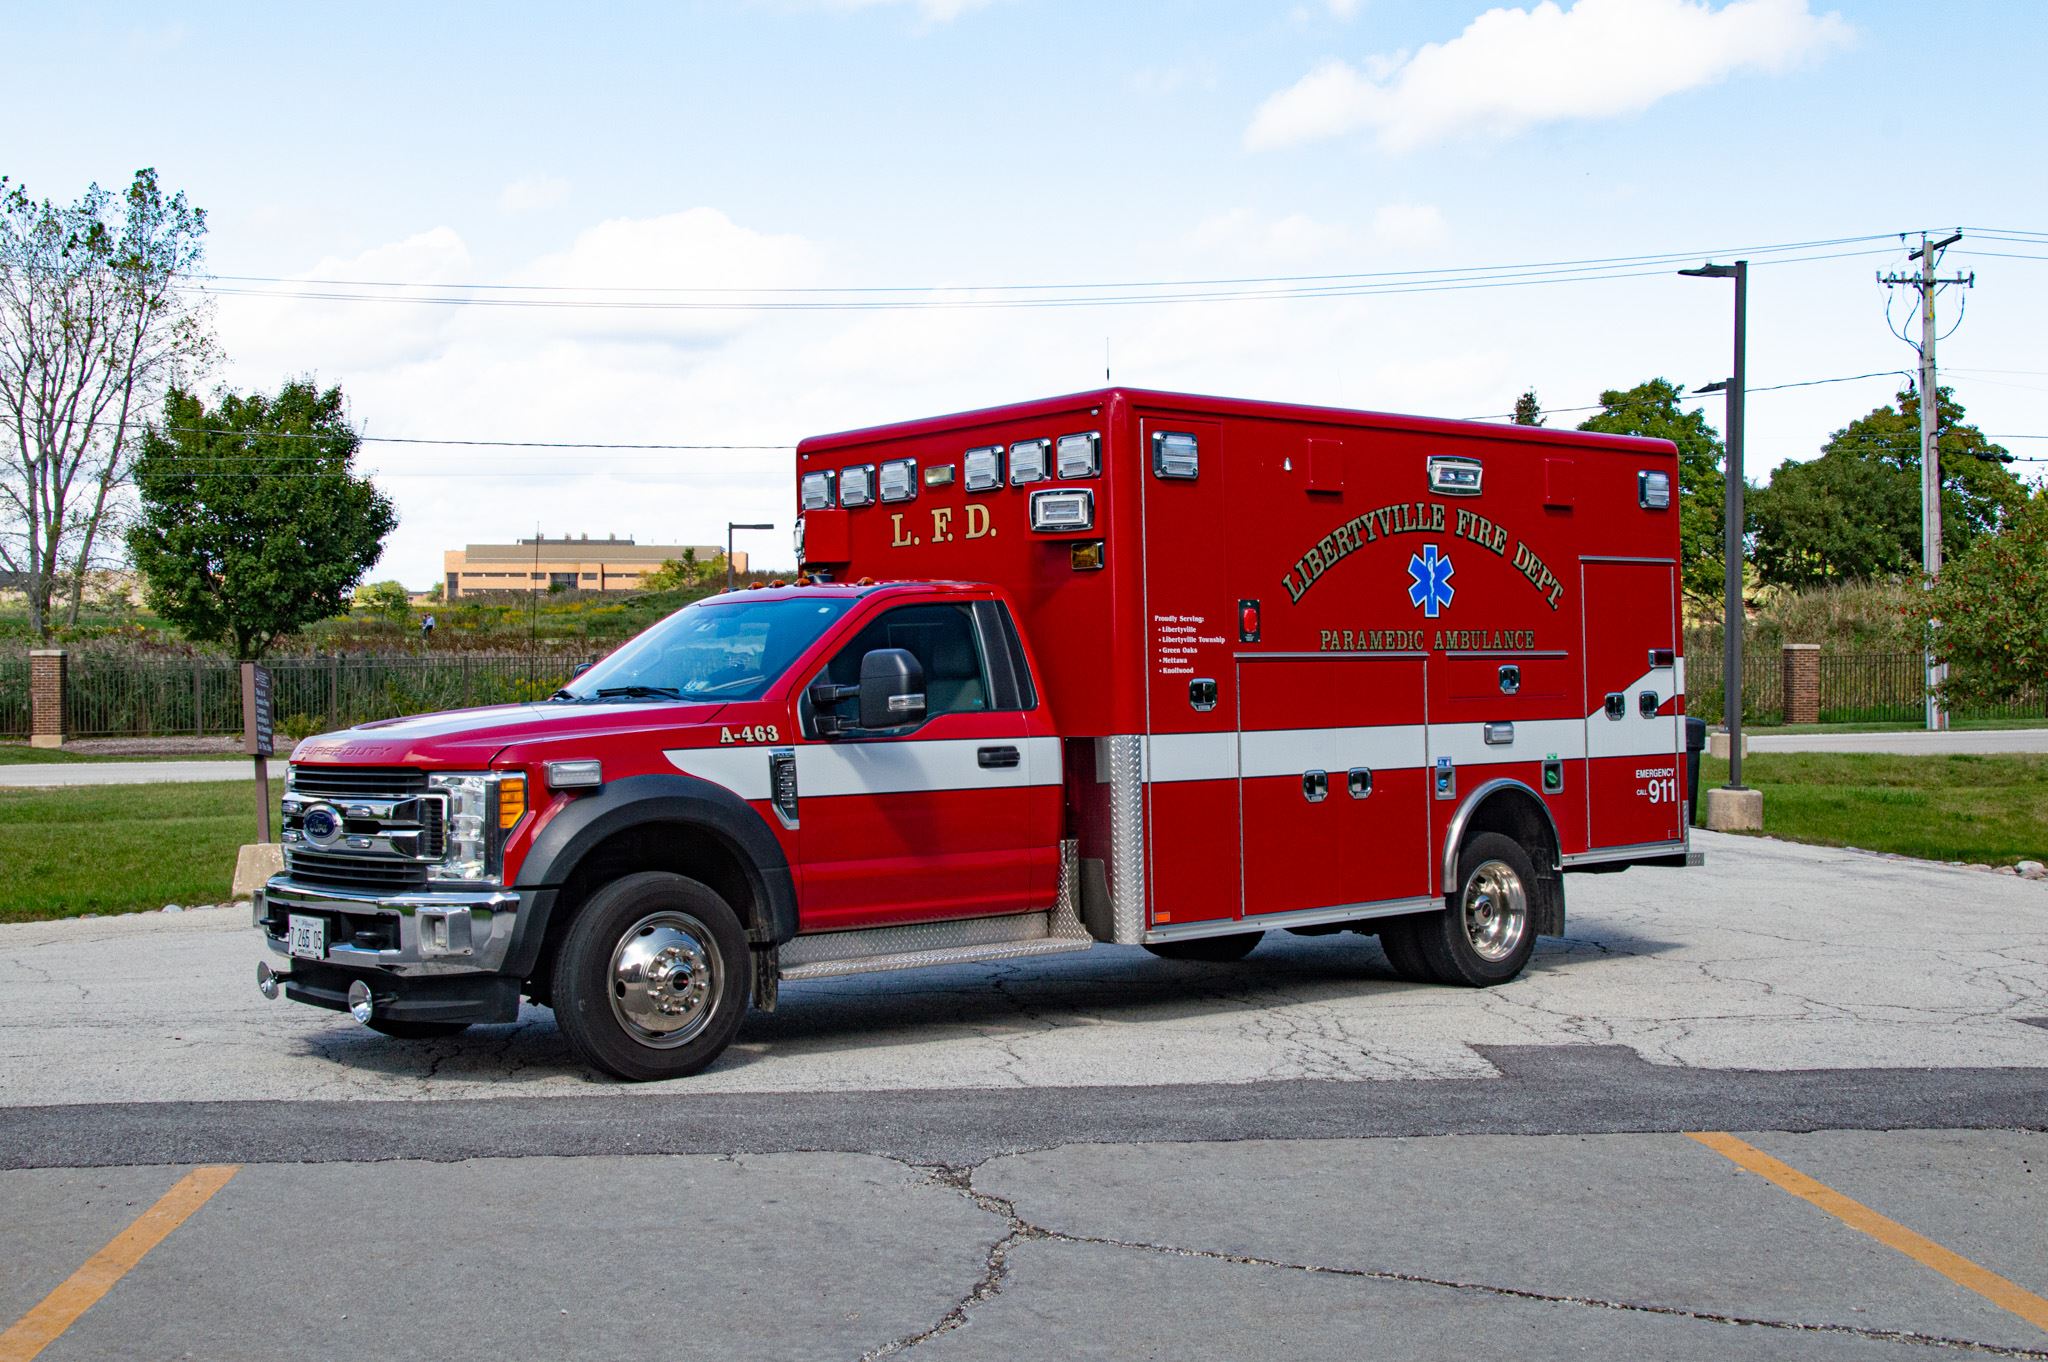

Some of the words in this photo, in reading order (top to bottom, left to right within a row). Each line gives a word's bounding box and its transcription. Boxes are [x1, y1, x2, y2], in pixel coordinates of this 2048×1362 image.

[891, 513, 920, 547] L.
[931, 507, 953, 543] F.
[965, 503, 997, 539] D.
[1282, 502, 1445, 602] LIBERTYVILLE
[1455, 508, 1508, 555] FIRE
[1512, 541, 1564, 610] DEPT.
[1154, 615, 1178, 623] Proudly
[1180, 615, 1205, 624] Serving:
[1162, 626, 1197, 634] Libertyville
[1162, 636, 1197, 644] Libertyville
[1198, 636, 1226, 644] Township
[1320, 630, 1424, 650] PARAMEDIC
[1433, 630, 1535, 650] AMBULANCE
[720, 725, 780, 744] A-463
[300, 746, 342, 757] SUPER
[342, 746, 393, 757] DUTY
[1636, 768, 1674, 778] EMERGENCY
[1648, 778, 1676, 803] 911
[308, 815, 328, 833] Ford
